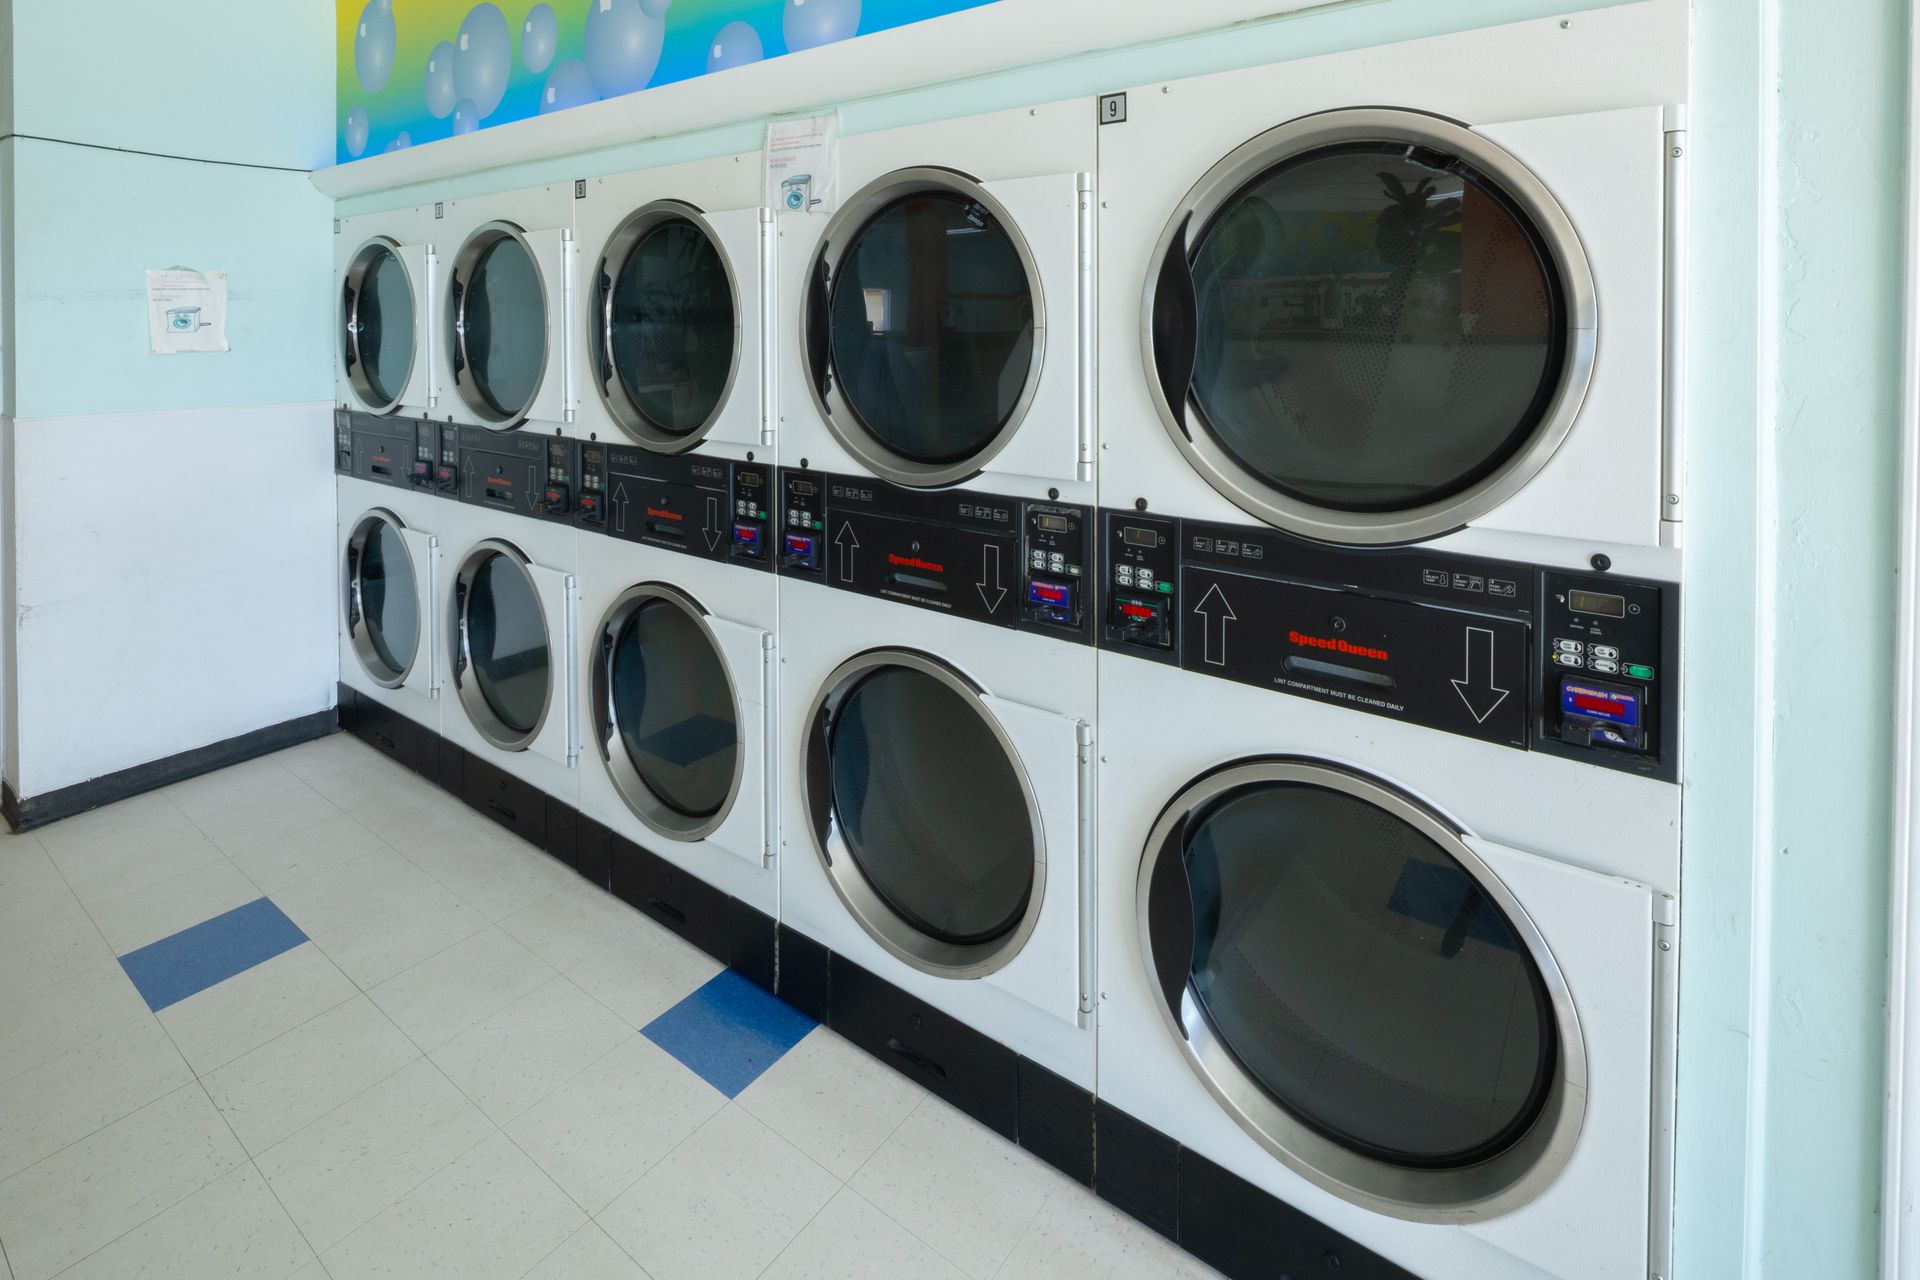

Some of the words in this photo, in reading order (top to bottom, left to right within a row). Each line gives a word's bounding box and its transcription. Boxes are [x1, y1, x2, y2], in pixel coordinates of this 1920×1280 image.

[1110, 100, 1117, 118] 9
[1289, 631, 1337, 650] Speed
[1337, 640, 1388, 661] Queen
[1274, 677, 1287, 685] LINT
[1287, 680, 1329, 695] COMPARTMENT
[1330, 690, 1347, 699] MUST
[1357, 696, 1386, 708] CLEANED
[1386, 702, 1405, 712] DAILY
